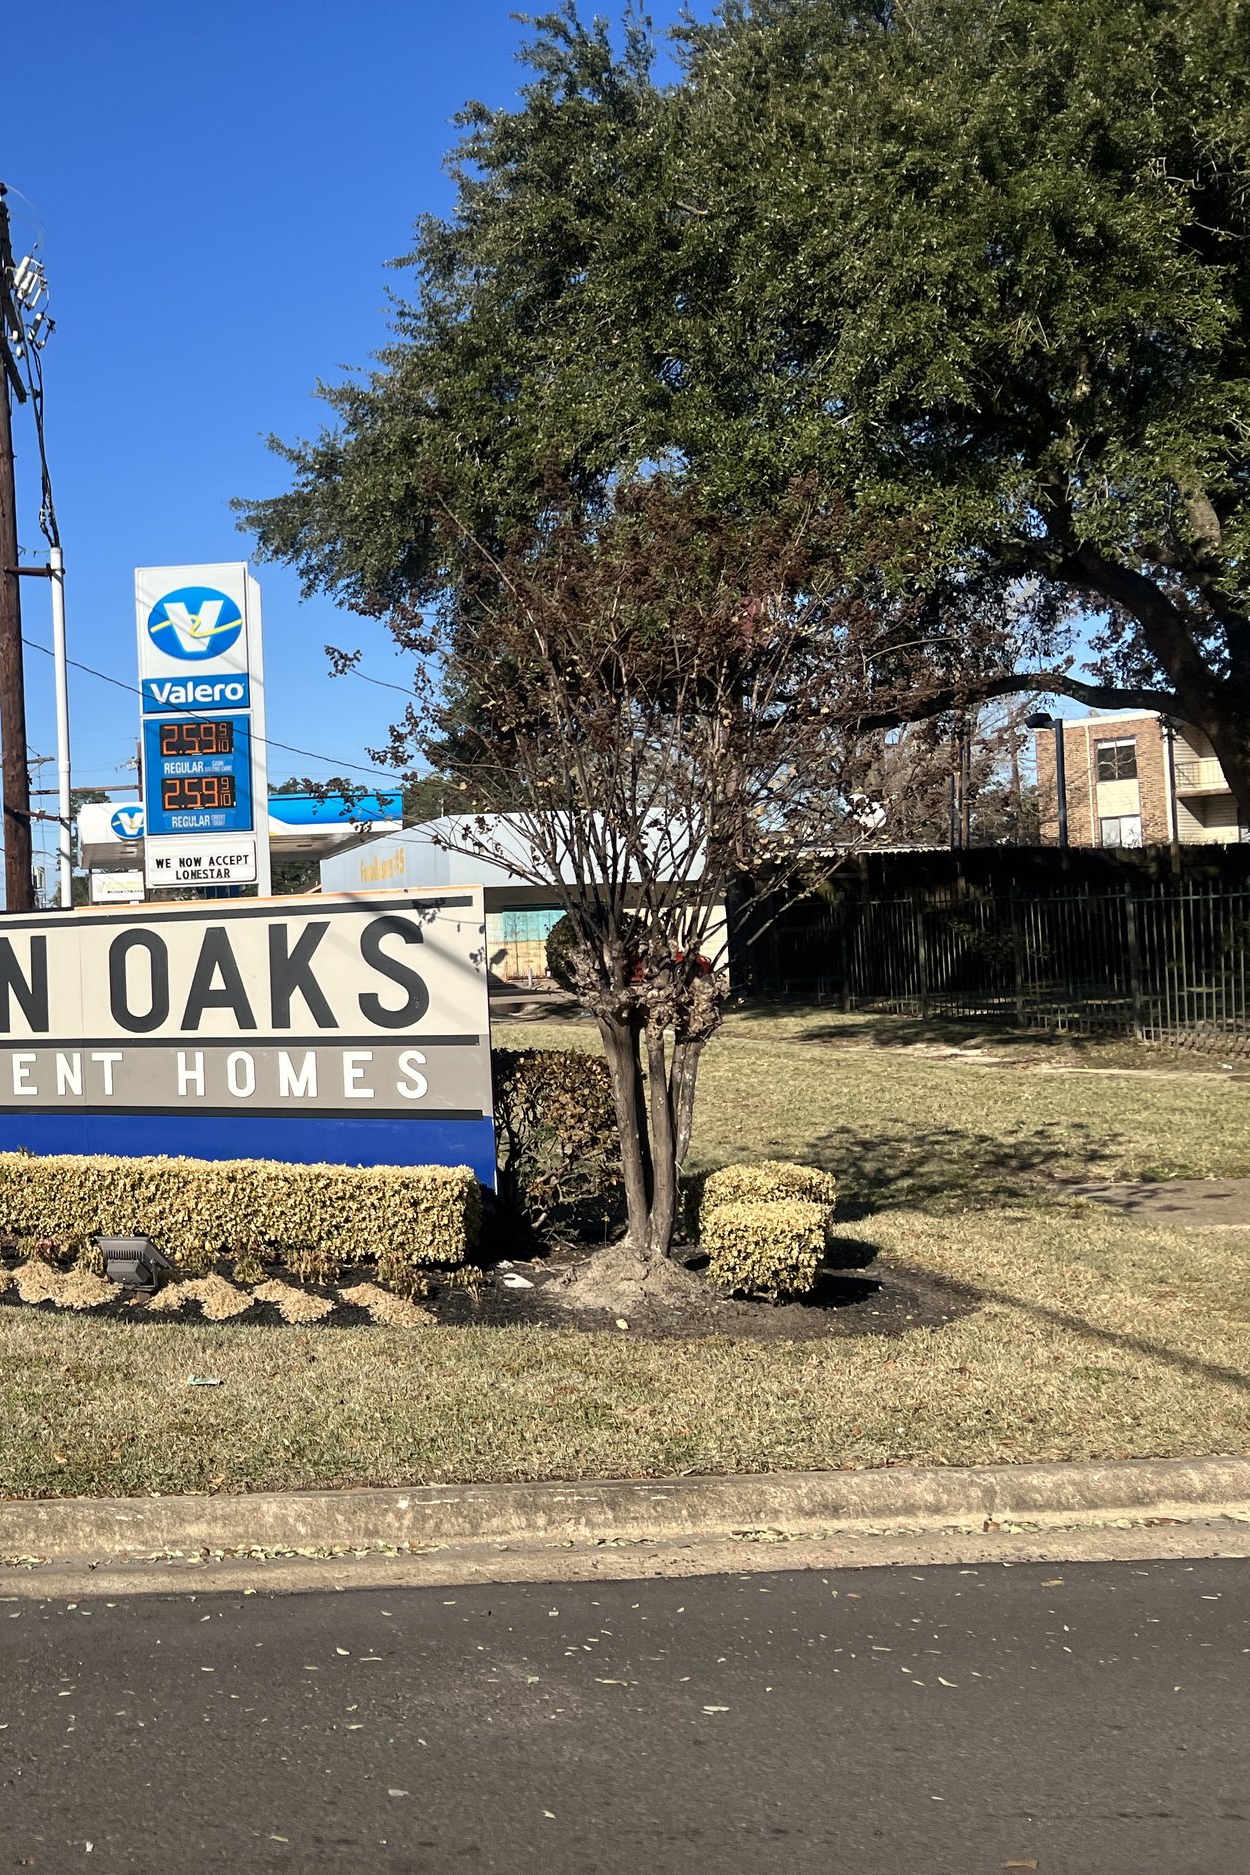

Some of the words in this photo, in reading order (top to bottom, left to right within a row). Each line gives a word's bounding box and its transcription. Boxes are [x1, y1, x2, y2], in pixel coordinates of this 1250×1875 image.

[150, 682, 244, 704] Valero
[164, 761, 204, 774] REGULAR
[172, 814, 211, 828] REGULAR
[155, 858, 171, 869] WE
[179, 857, 202, 868] NOW
[208, 854, 250, 866] ACCEPT
[175, 868, 231, 881] LONESTAR
[108, 915, 430, 1033] OAKS
[177, 1048, 429, 1100] HOMES
